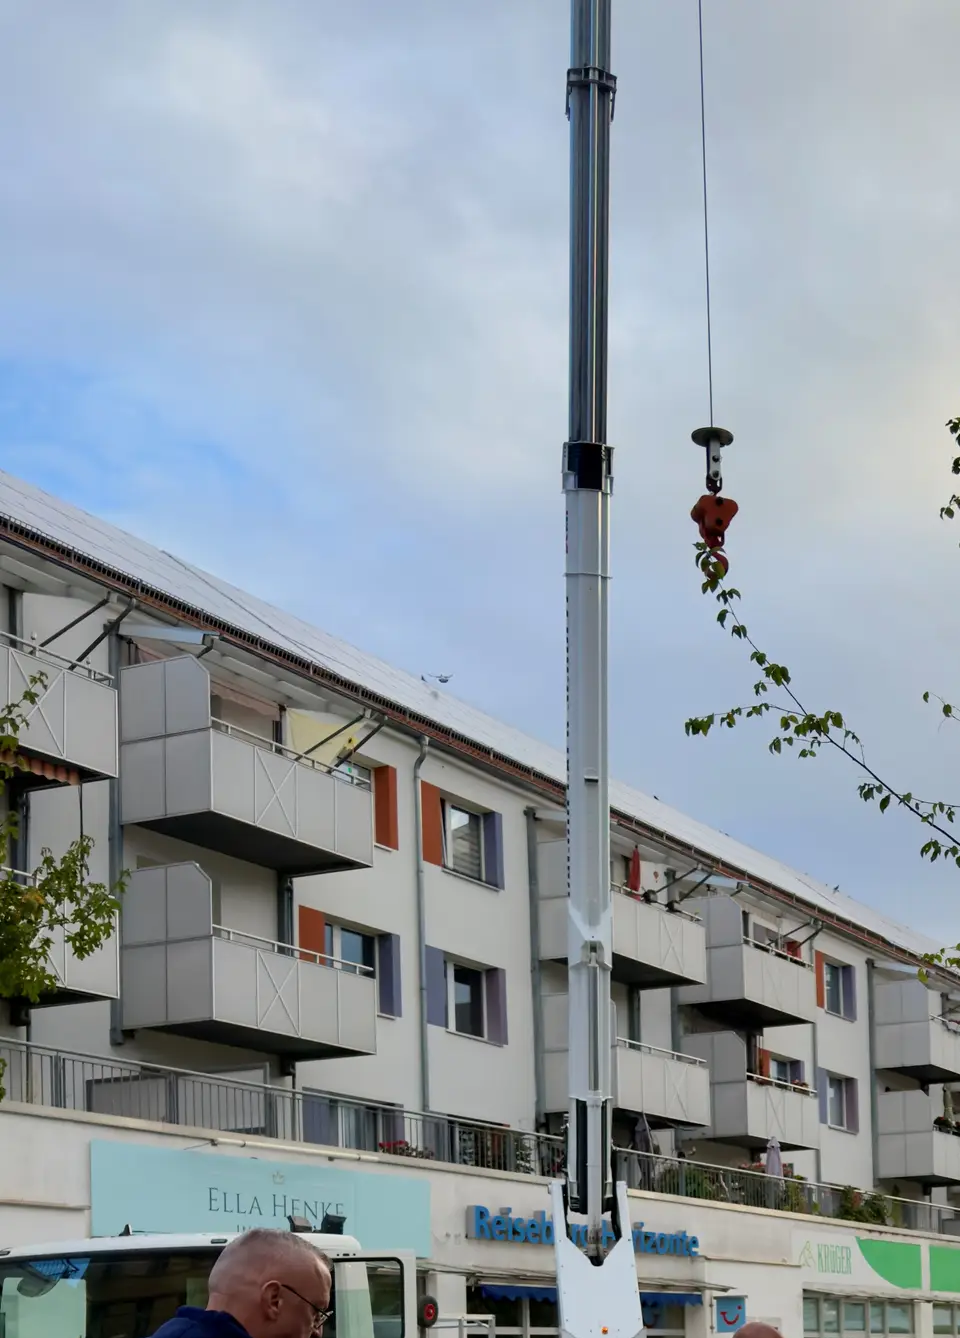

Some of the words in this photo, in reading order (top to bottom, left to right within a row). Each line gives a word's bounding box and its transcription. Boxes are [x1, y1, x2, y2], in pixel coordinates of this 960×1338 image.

[208, 1187, 263, 1215] ELLA
[272, 1194, 344, 1219] HENKE
[474, 1205, 588, 1249] Reisebr
[602, 1219, 700, 1257] Hizonte
